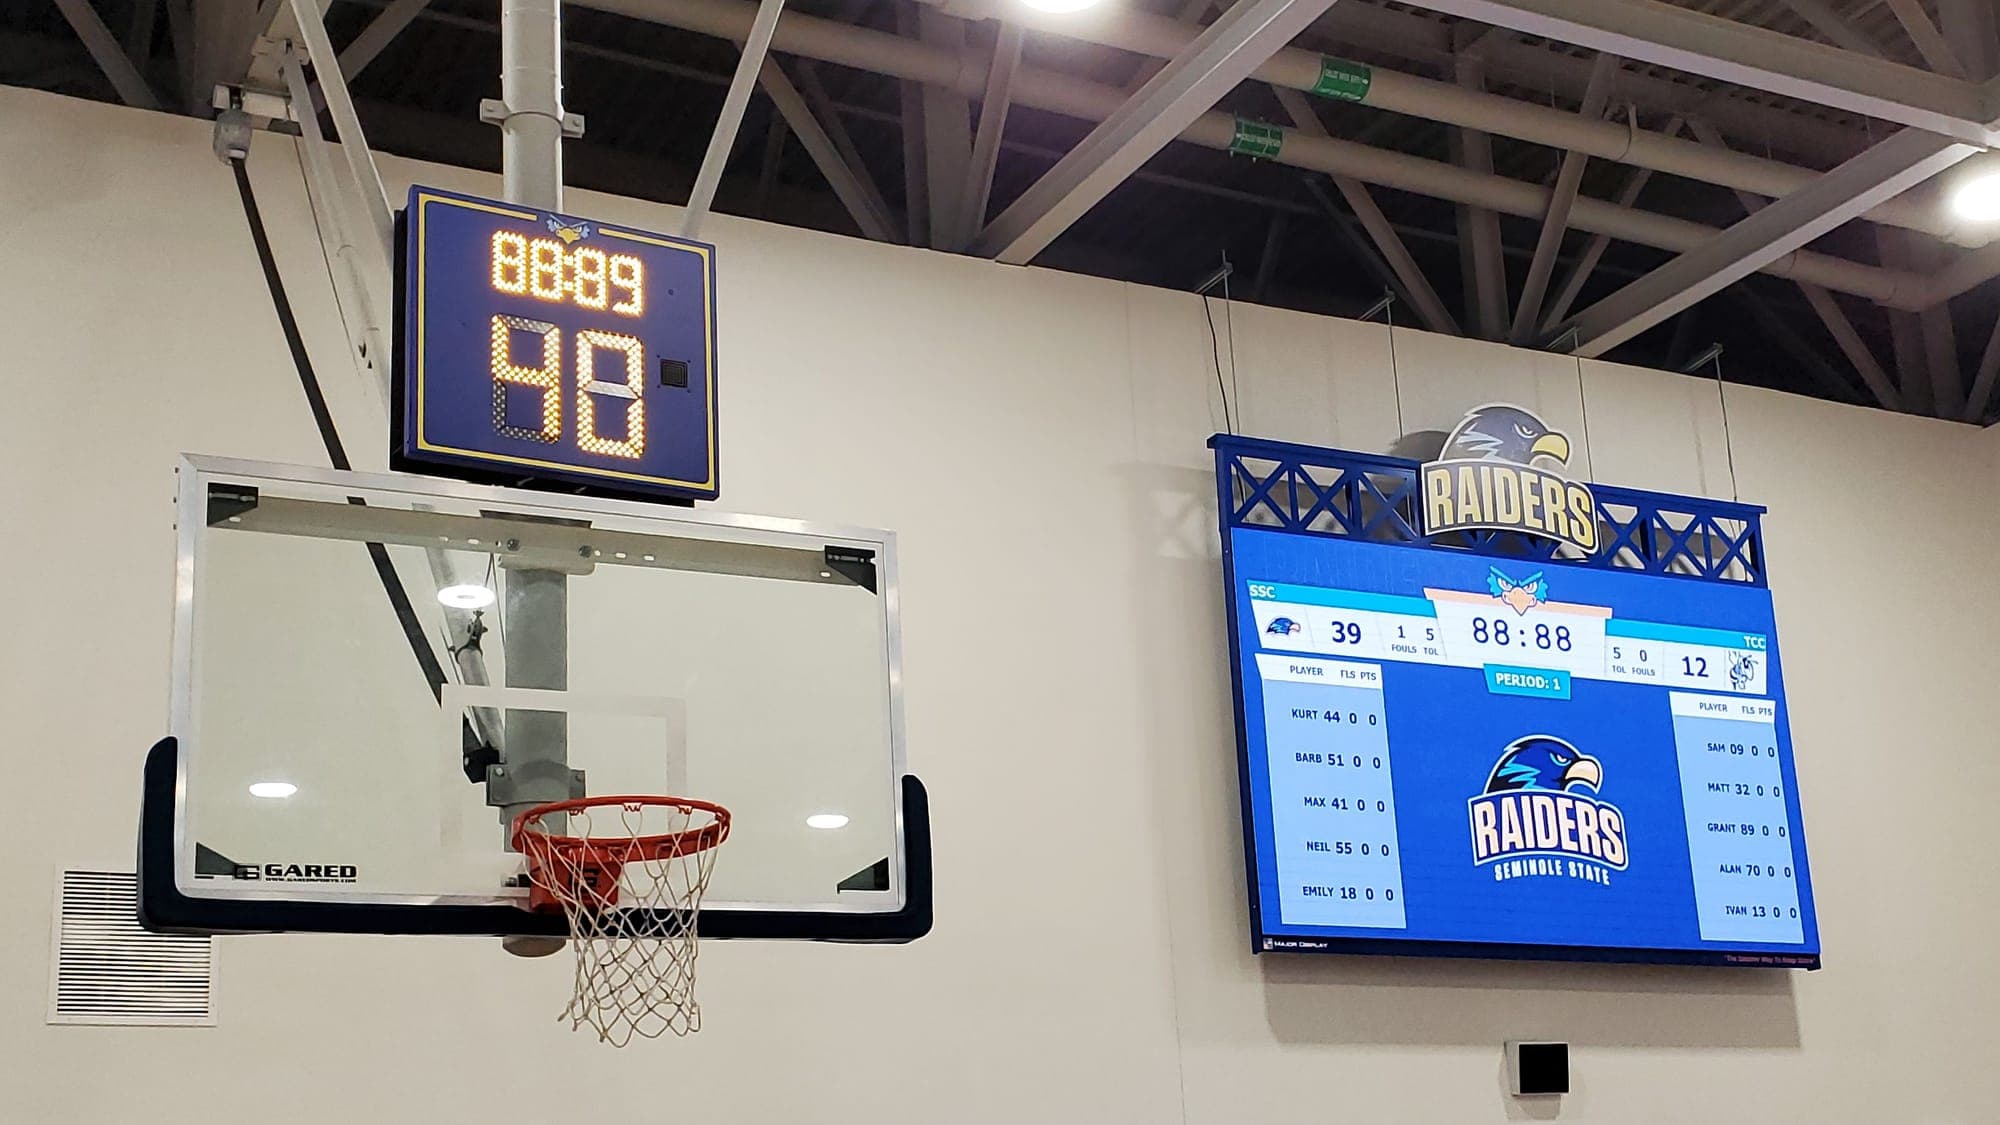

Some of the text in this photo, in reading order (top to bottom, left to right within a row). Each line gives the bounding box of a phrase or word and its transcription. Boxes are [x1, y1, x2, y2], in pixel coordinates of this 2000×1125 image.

[492, 230, 644, 317] 88:89
[491, 314, 644, 459] 40
[1427, 466, 1594, 547] RAIDERS
[1249, 584, 1276, 599] SSC
[1331, 621, 1362, 644] 39
[1397, 625, 1434, 641] 1 5
[1391, 643, 1439, 656] FOULS TOL
[1743, 635, 1766, 649] TCC
[1613, 647, 1648, 663] 5 0
[1289, 664, 1377, 681] PLAYER FLS PTS
[1612, 665, 1656, 677] TOL FOULS
[1681, 656, 1709, 678] 12
[1495, 672, 1561, 690] PERIOD: 1
[1699, 701, 1728, 712] PLAYER
[1758, 707, 1773, 716] PTS
[1291, 708, 1377, 726] KURT 44 0 0
[1707, 742, 1775, 758] SAM 09 0 0
[1295, 752, 1381, 769] BARB 51 0 0
[1707, 782, 1780, 797] MATT 32 0 0
[1304, 796, 1385, 812] MAX 41 0 0
[1473, 795, 1625, 865] RAIDERS
[1707, 823, 1786, 837] GRANT 89 0 0
[1306, 841, 1389, 856] NEIL 55 0 0
[264, 863, 357, 878] GARED
[1494, 858, 1610, 886] SEMINOLE STATE
[1720, 864, 1791, 878] ALAN 70 0 0
[1302, 886, 1394, 901] EMILY 18 0 0
[1725, 905, 1797, 919] IVAN 13 0 0
